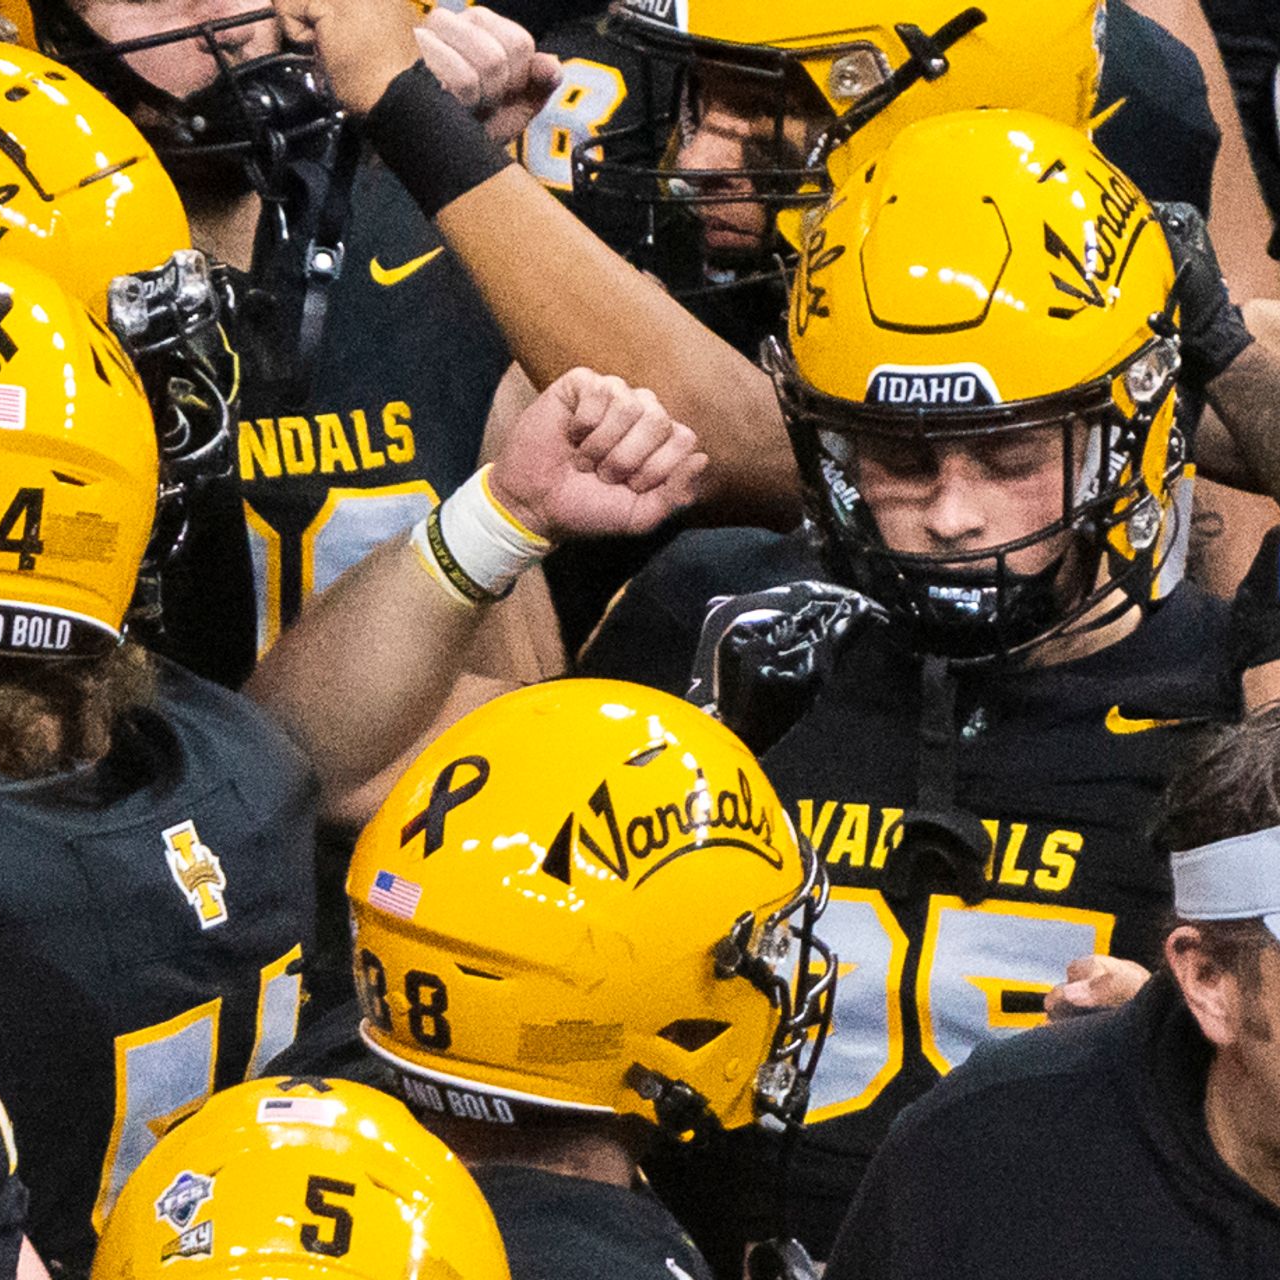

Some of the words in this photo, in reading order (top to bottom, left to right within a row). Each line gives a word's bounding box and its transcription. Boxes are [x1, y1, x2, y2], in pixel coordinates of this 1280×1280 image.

[877, 374, 977, 403] IDAHO
[11, 615, 71, 650] BOLD
[446, 1089, 515, 1125] BOLD
[299, 1174, 356, 1259] 5
